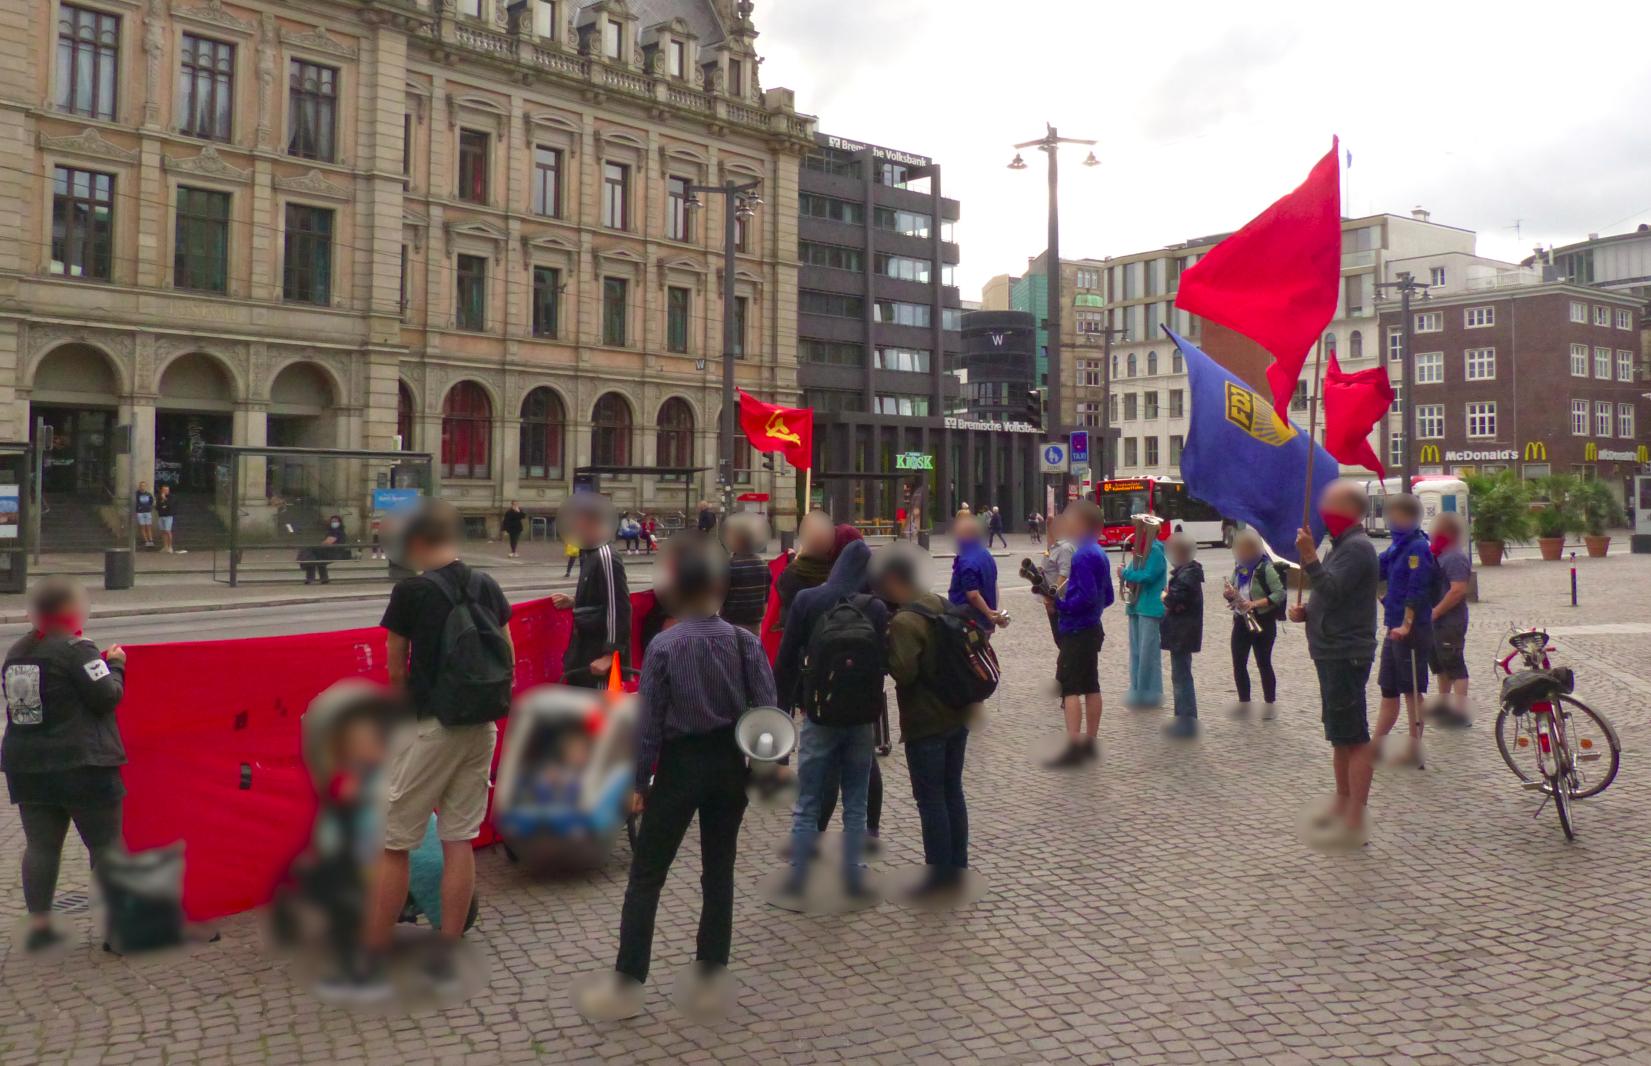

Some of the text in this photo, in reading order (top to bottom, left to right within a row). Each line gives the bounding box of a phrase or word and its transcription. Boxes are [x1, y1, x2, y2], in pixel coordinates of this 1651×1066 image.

[886, 149, 927, 167] Volksbank
[958, 419, 1002, 432] Bremische
[1072, 452, 1088, 460] TAXI
[1445, 450, 1519, 461] McDonald's
